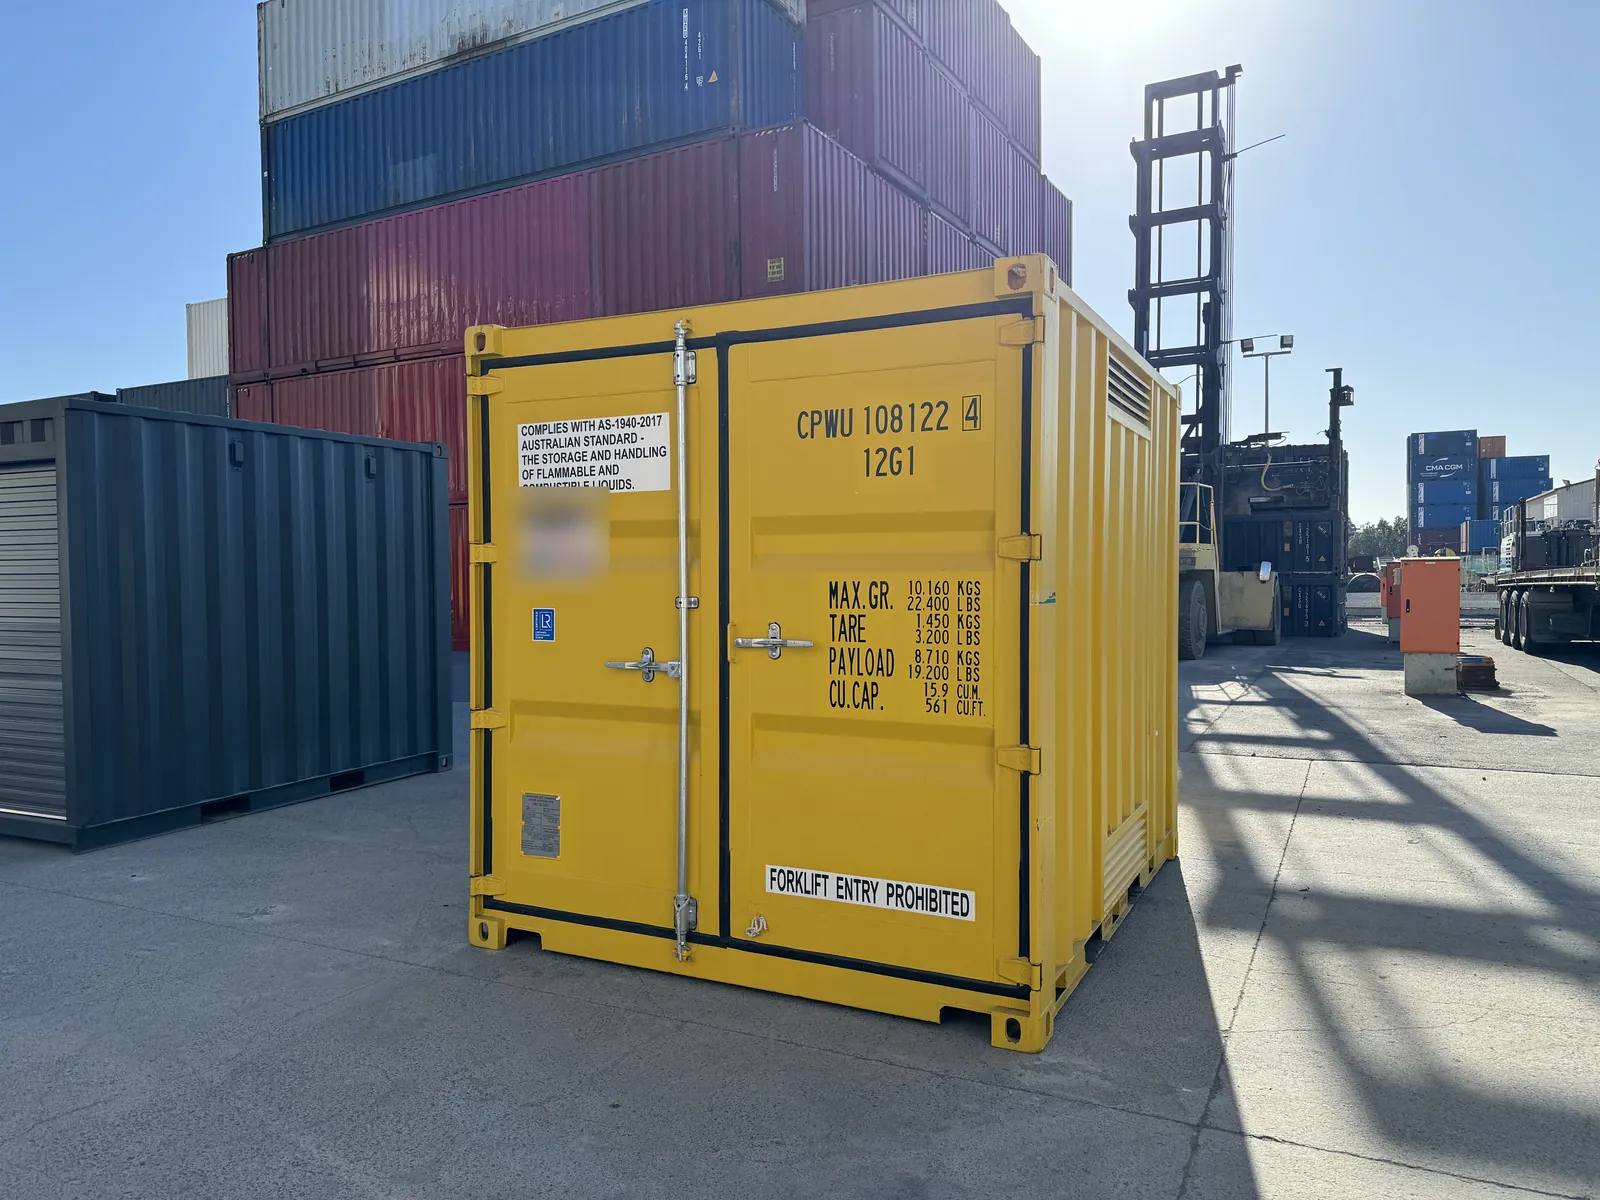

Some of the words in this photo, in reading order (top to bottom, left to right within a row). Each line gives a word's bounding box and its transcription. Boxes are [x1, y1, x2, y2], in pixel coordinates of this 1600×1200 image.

[521, 422, 569, 436] COMPLIES
[570, 420, 596, 433] WITH
[598, 415, 663, 431] AS-1940-2017
[797, 408, 853, 439] CPWU
[863, 400, 949, 435] 108122
[964, 397, 979, 428] 4
[522, 436, 581, 451] AUSTRALIAN
[583, 432, 638, 447] STANDARD
[522, 454, 540, 466] THE
[542, 451, 588, 464] STORAGE
[590, 449, 611, 462] AND
[614, 446, 667, 460] HANDLING
[863, 445, 914, 478] 12G1
[522, 469, 534, 480] OF
[537, 466, 596, 479] FLAMMABLE
[598, 464, 620, 476] AND
[828, 580, 894, 610] MAX.GR.
[957, 580, 981, 596] KGS
[957, 597, 981, 612] LBS
[541, 613, 551, 629] LR
[829, 614, 867, 643] TARE
[957, 614, 981, 630] KGS
[957, 630, 980, 646] LBS
[829, 647, 895, 677] PAYLOAD
[957, 650, 980, 666] KGS
[956, 666, 980, 682] LBS
[829, 679, 884, 711] CU.CAP.
[924, 682, 949, 698] 15.9
[956, 684, 981, 700] CU.M.
[925, 697, 947, 714] 561
[956, 700, 986, 717] CU.FT.
[770, 867, 830, 898] FORKLIFT
[836, 876, 880, 904] ENTRY
[886, 882, 970, 918] PROHIBITED
